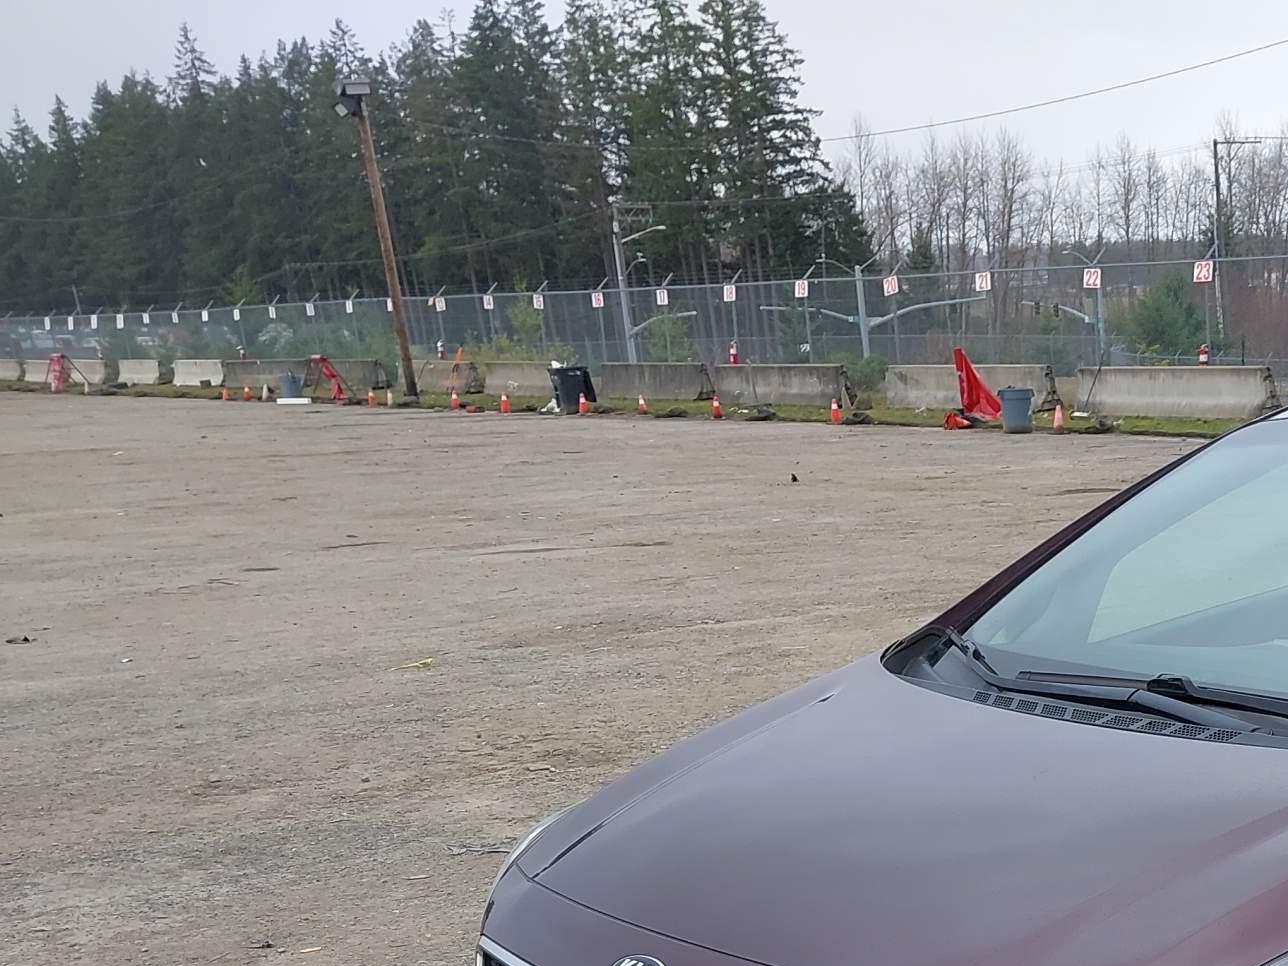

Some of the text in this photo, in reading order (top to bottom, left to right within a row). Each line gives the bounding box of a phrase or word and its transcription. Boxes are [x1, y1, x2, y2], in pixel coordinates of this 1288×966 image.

[1086, 270, 1099, 287] 22
[1196, 262, 1211, 281] 23
[797, 281, 806, 296] 19
[885, 277, 897, 294] 20
[978, 273, 988, 290] 21
[726, 286, 734, 300] 18
